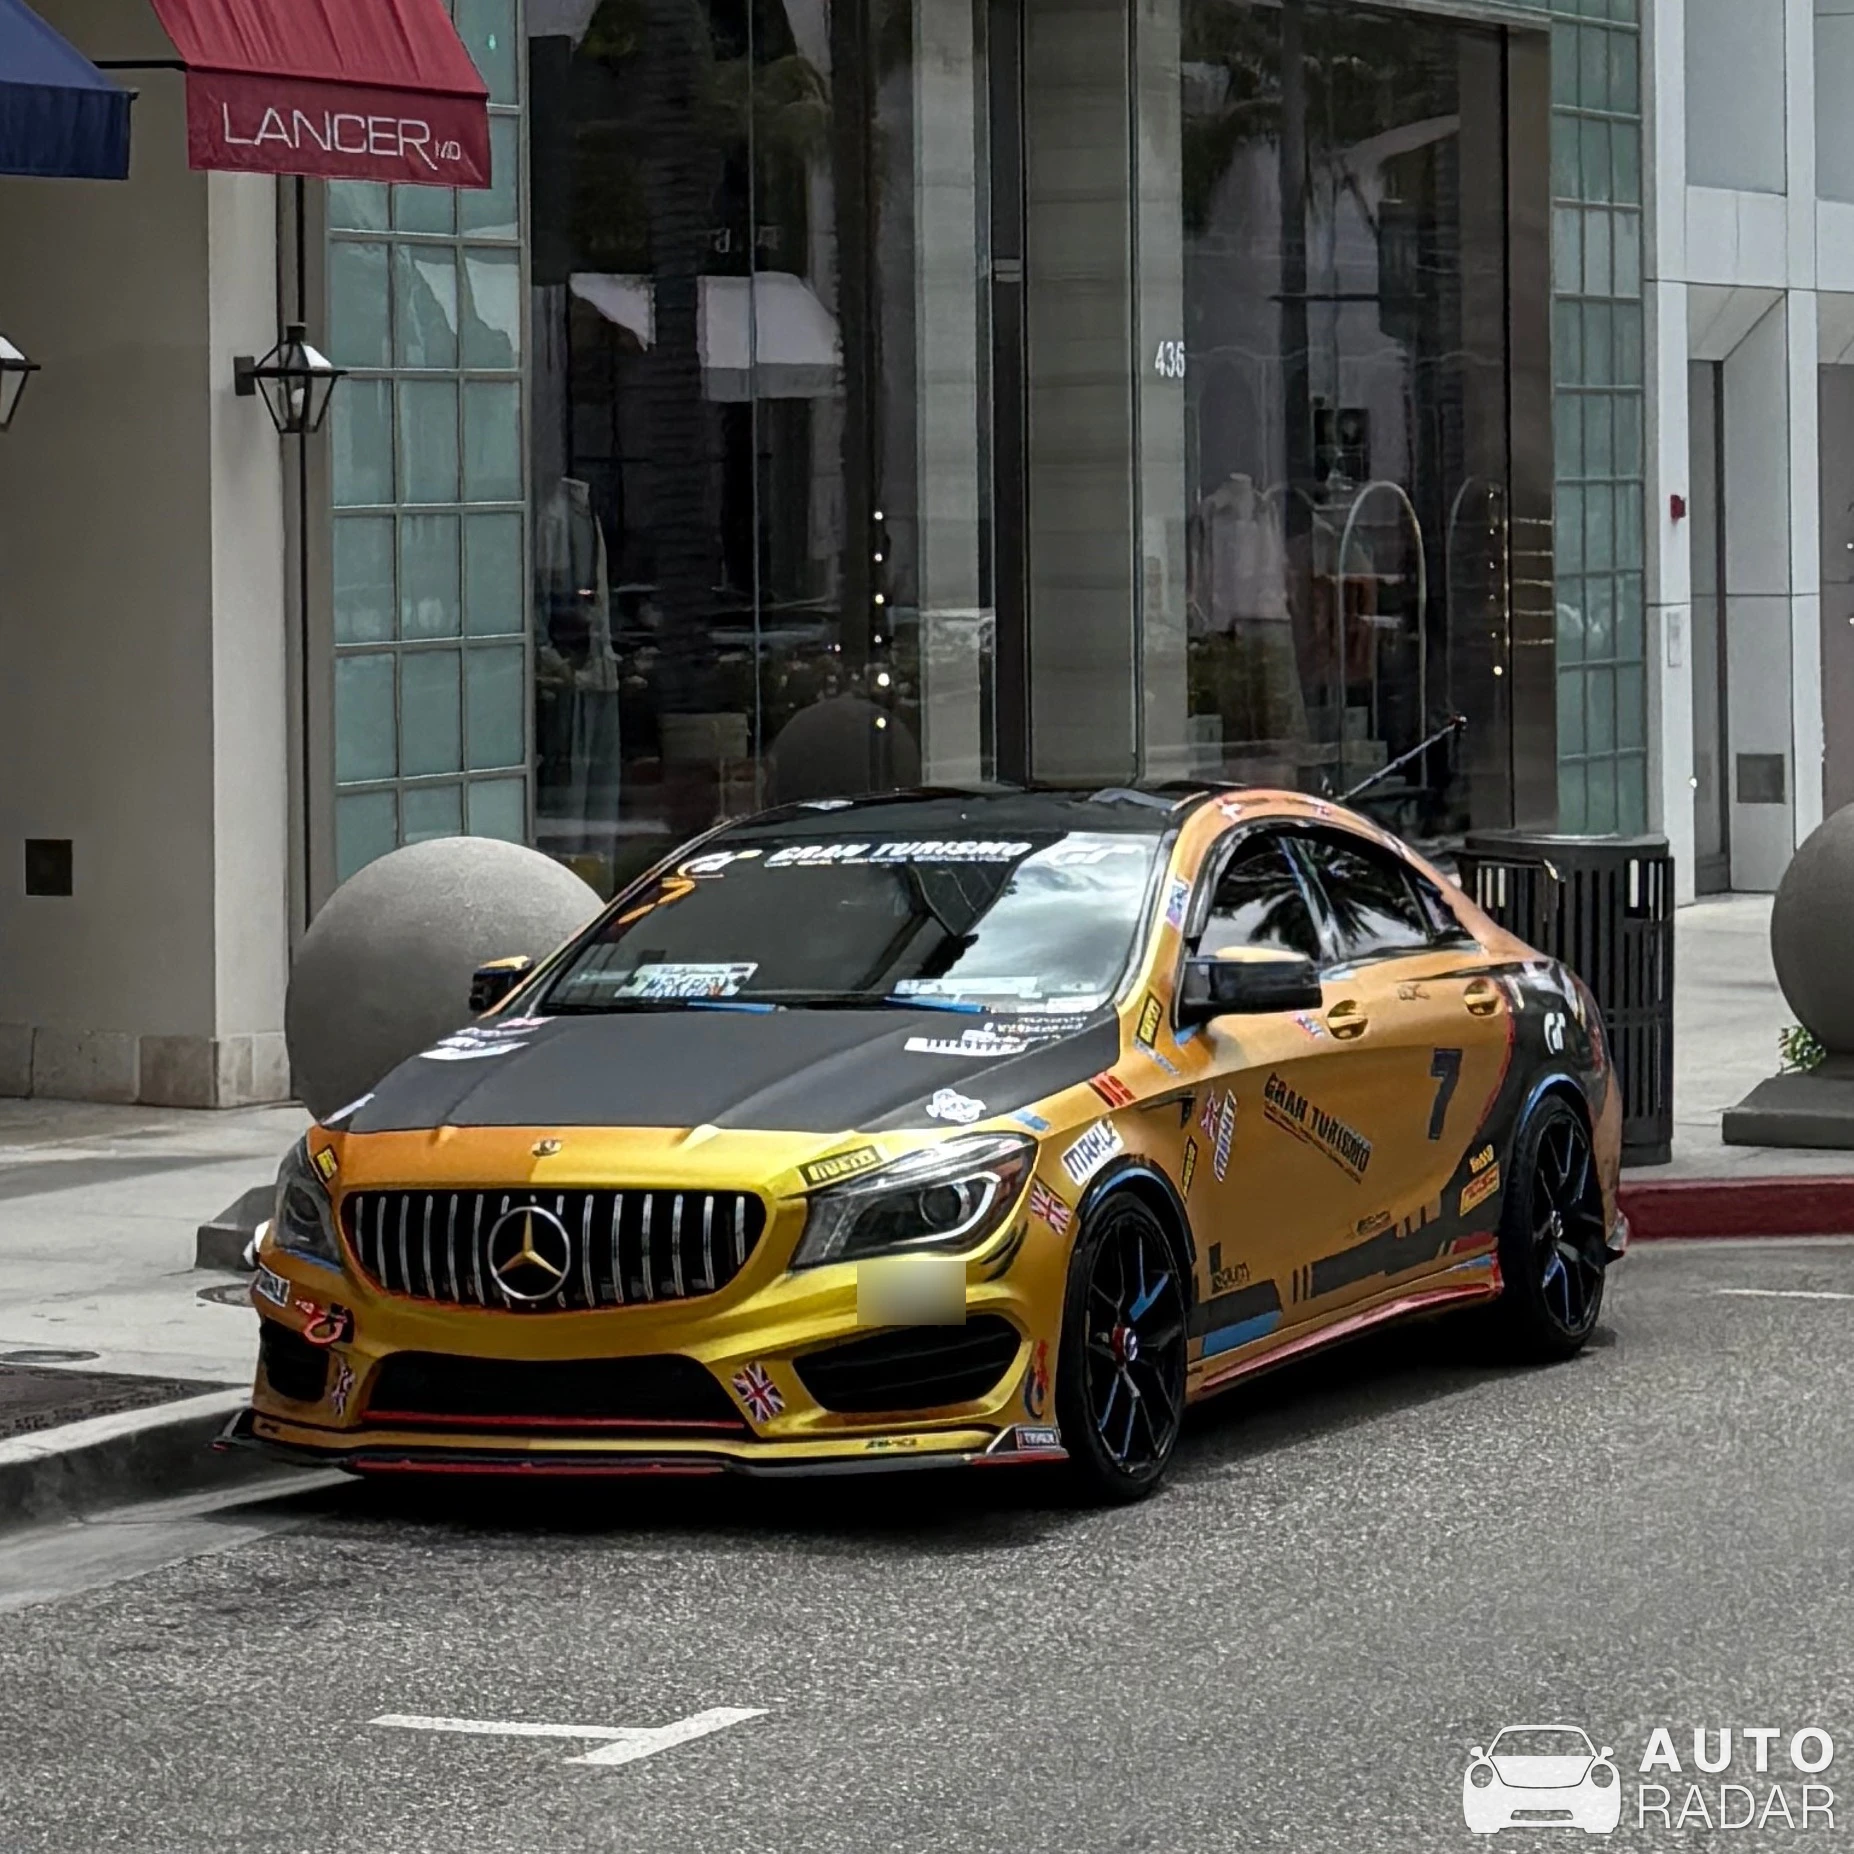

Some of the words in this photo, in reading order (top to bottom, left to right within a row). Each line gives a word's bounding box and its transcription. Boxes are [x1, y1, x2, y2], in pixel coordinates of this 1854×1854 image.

[222, 101, 438, 171] LANCER
[1154, 340, 1185, 378] 436
[1264, 1072, 1308, 1122] GRAN
[1311, 1105, 1371, 1171] TURISMO
[1428, 1047, 1463, 1141] 7
